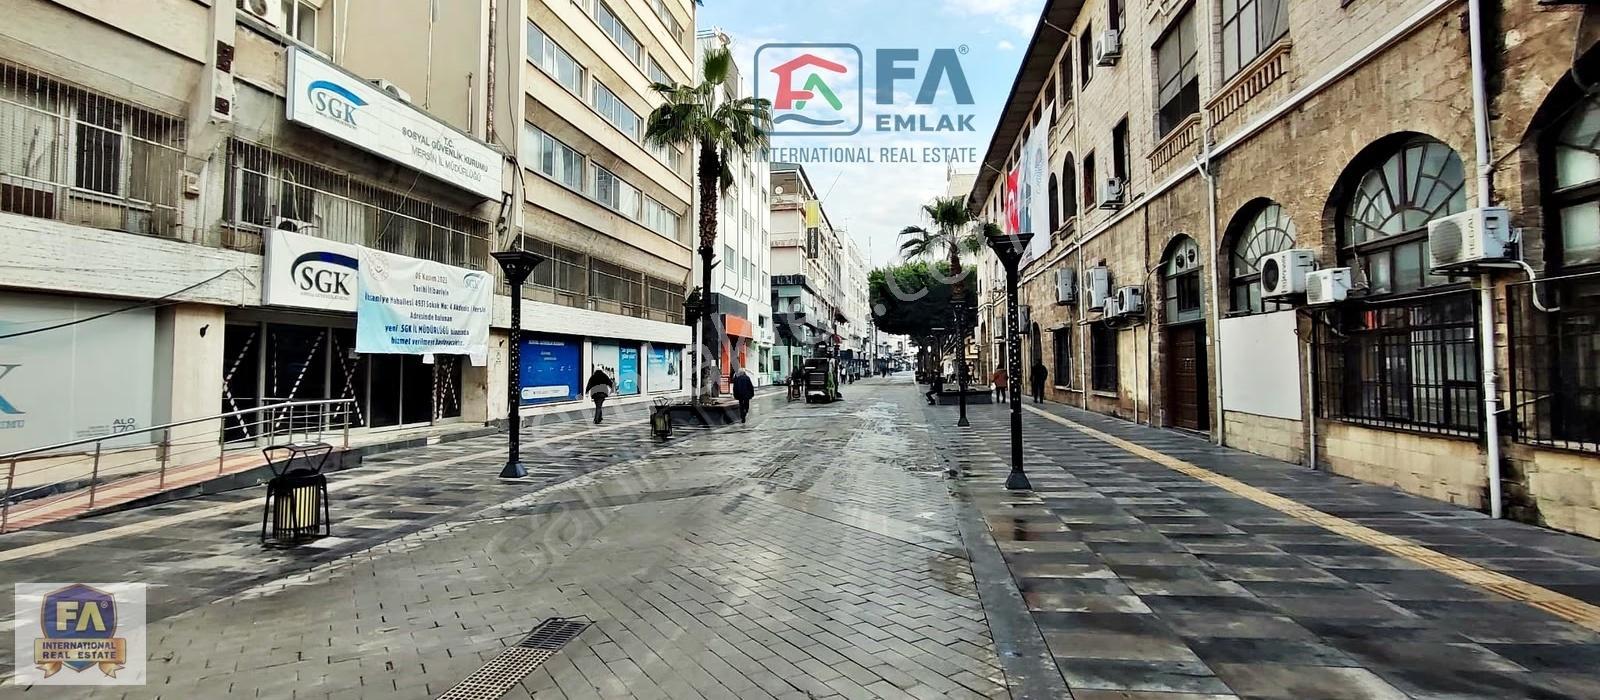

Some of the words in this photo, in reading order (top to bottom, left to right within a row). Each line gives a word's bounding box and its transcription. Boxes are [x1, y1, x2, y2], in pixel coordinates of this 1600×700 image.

[315, 91, 357, 126] SGK
[401, 126, 430, 147] SOSYAL
[300, 265, 351, 296] SGK
[400, 324, 413, 333] SGK
[113, 417, 136, 425] ALO
